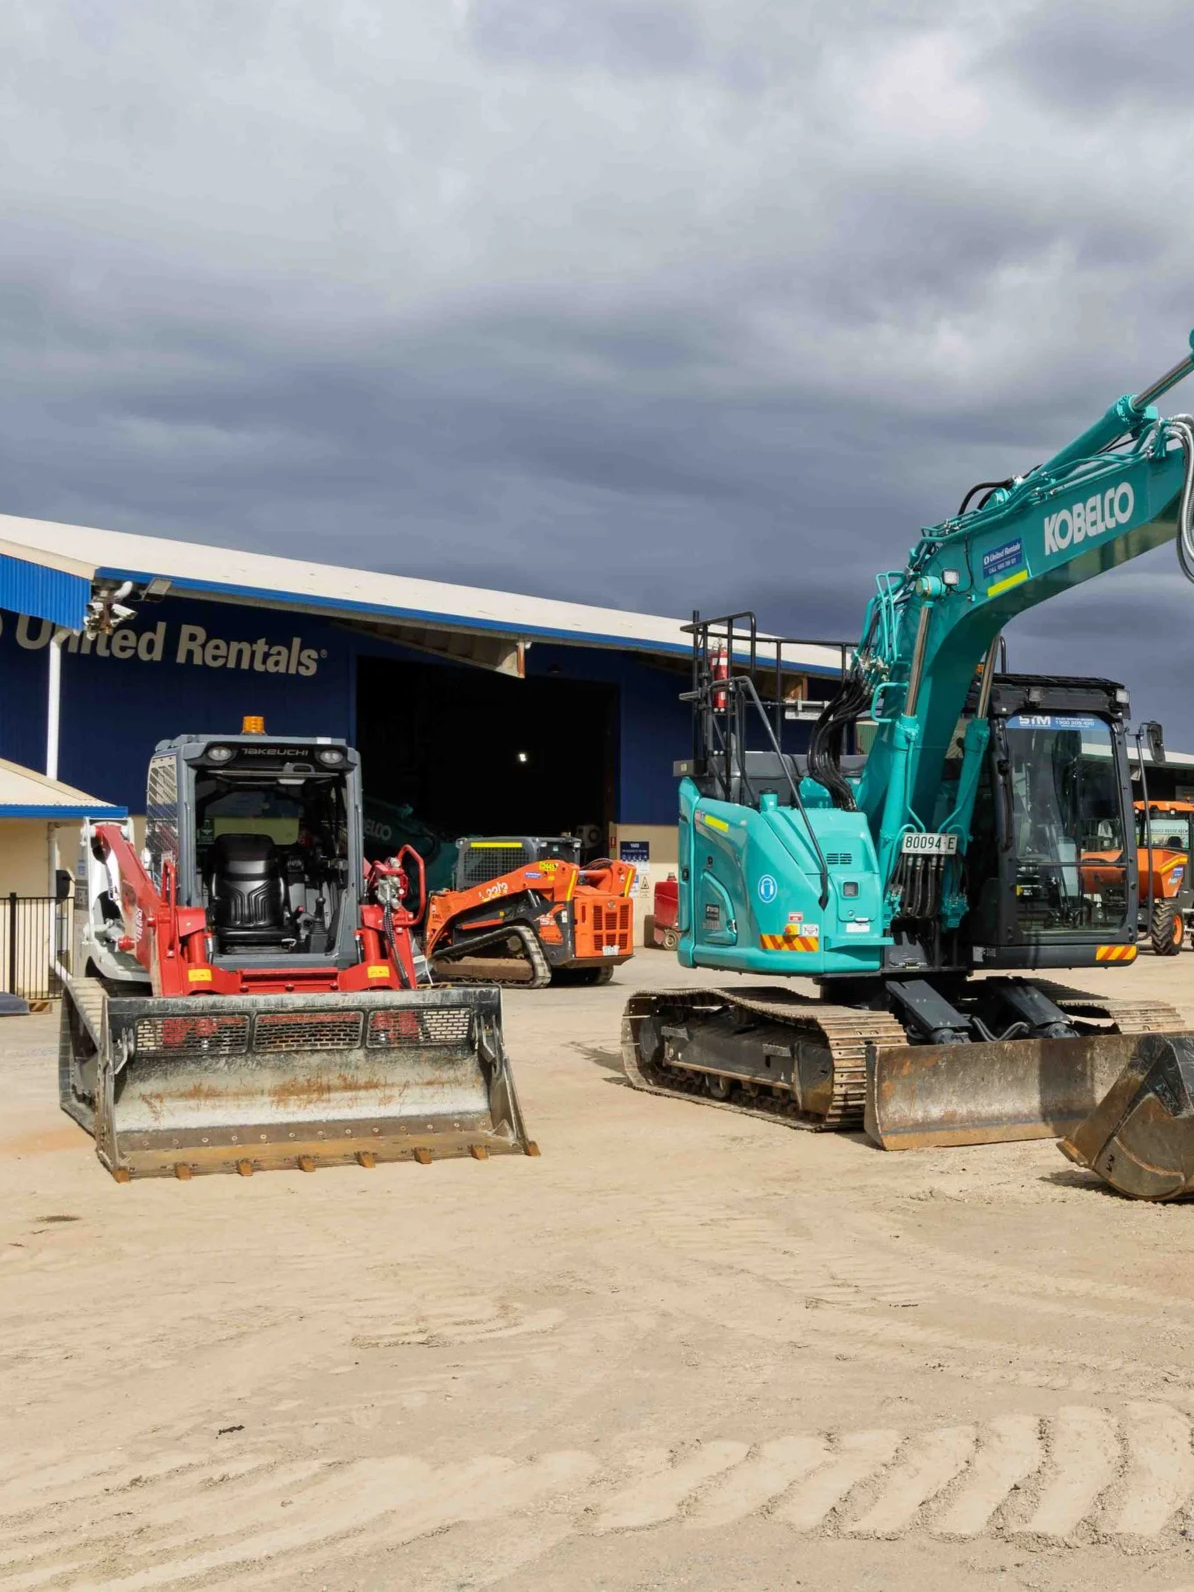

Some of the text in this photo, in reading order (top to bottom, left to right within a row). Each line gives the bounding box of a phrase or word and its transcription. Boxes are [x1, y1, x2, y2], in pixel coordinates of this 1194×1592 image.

[1044, 482, 1134, 556] KOBELCO
[176, 624, 318, 676] Rentals
[241, 748, 309, 757] TAKEUCHI
